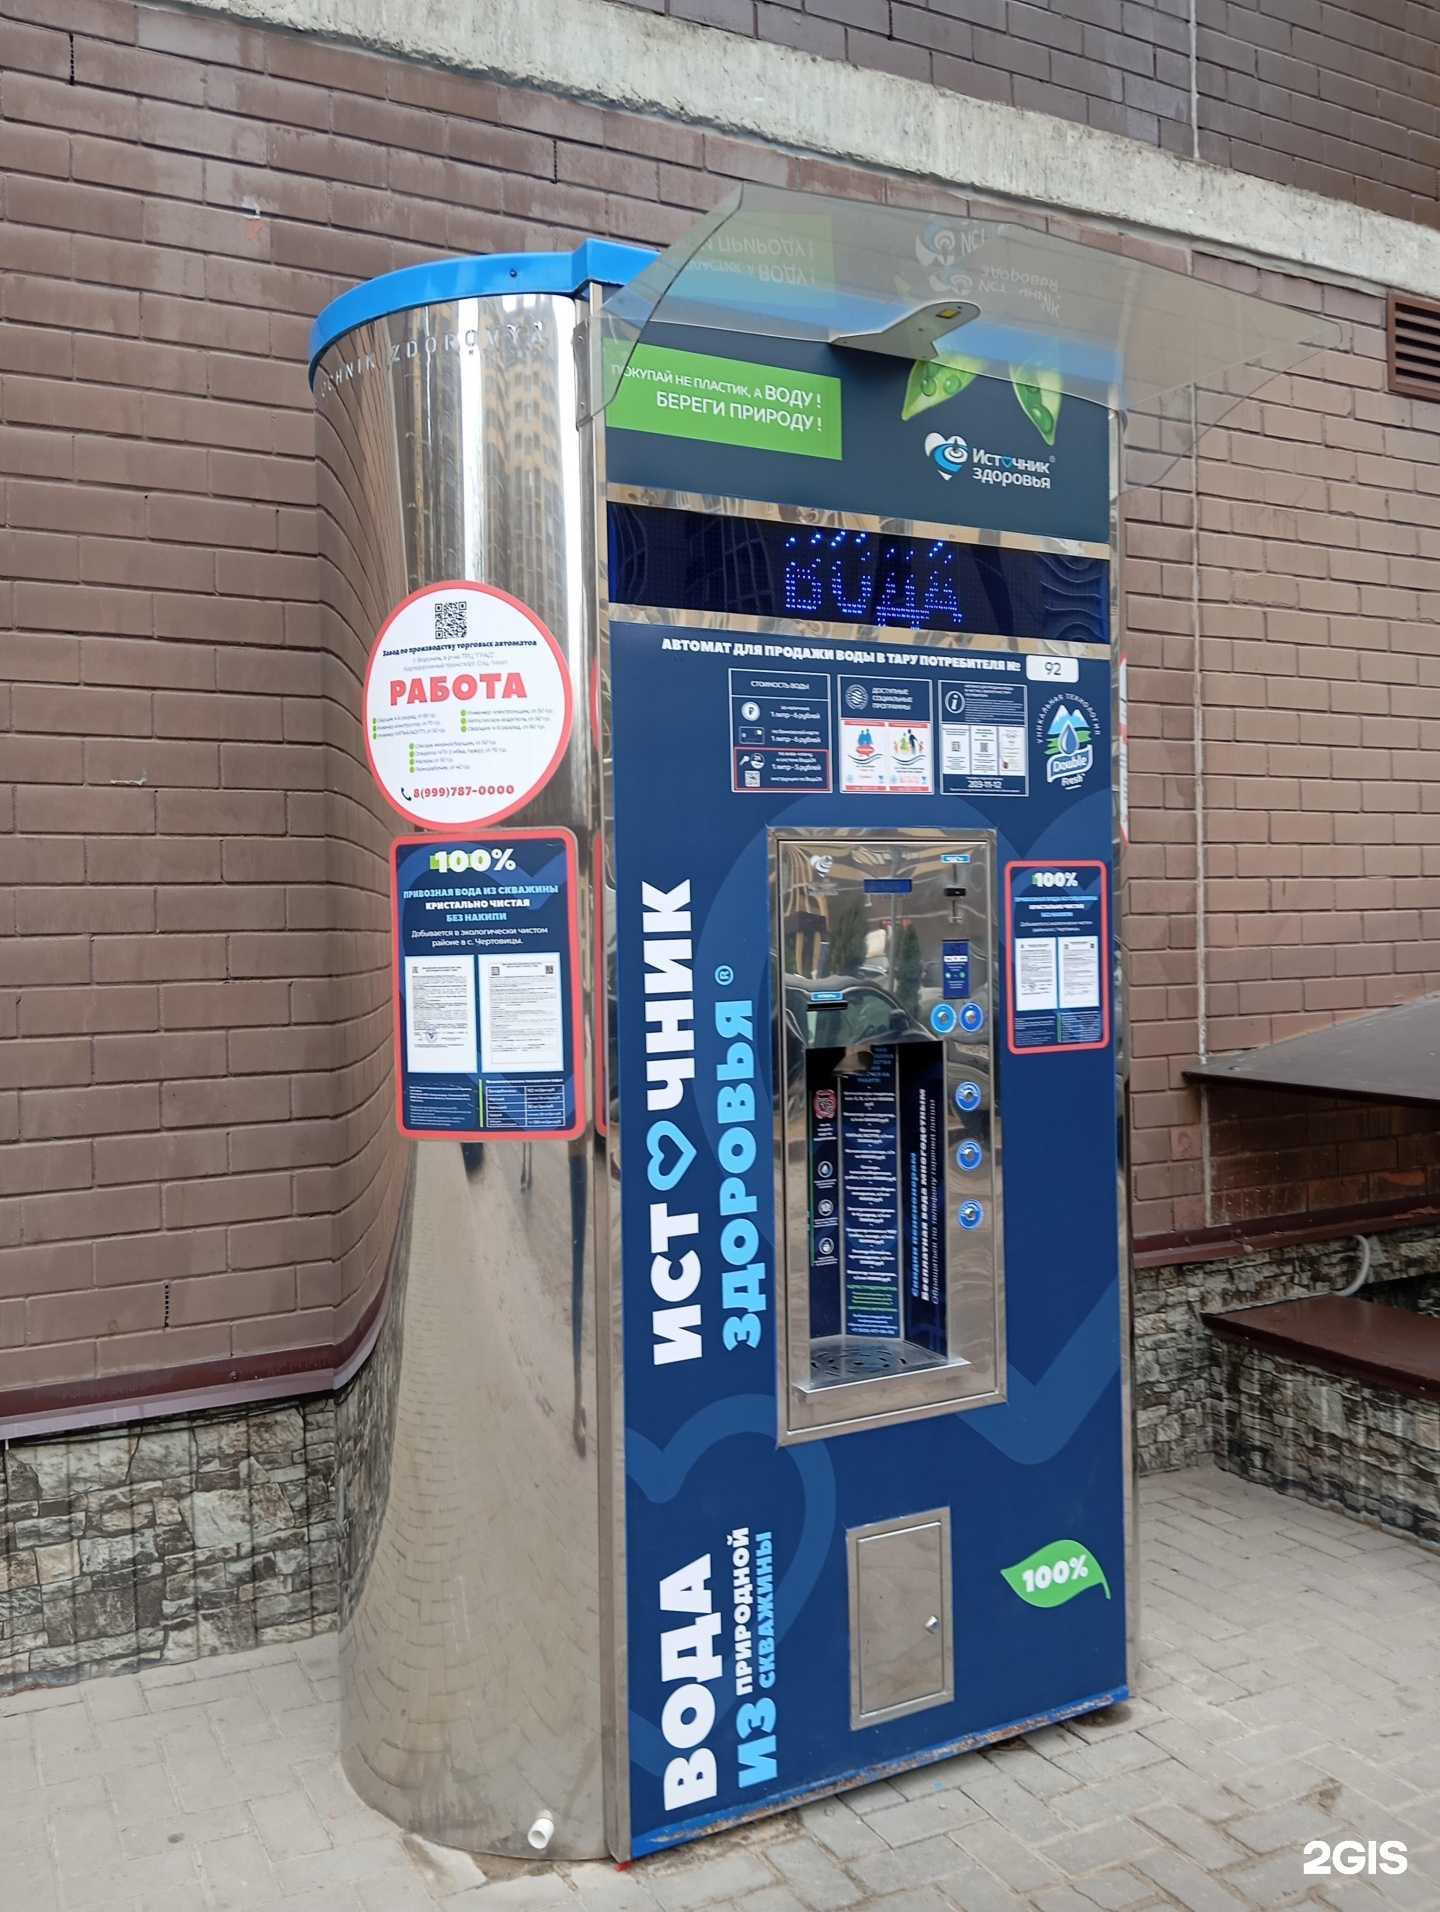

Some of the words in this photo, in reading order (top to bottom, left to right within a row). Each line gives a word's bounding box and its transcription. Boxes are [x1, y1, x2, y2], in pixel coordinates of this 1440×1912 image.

[611, 364, 673, 385] ПОКУПАЙ
[675, 374, 692, 388] НЕ
[693, 378, 751, 397] ПЛАСТИК,
[656, 391, 725, 416] БЕРЕГИ
[409, 643, 456, 655] производству
[456, 641, 494, 650] торговых
[494, 639, 537, 648] автоматов
[661, 638, 732, 653] АВТОМАТ
[733, 642, 763, 657] ДЛЯ
[764, 644, 834, 660] ПРОДАЖИ
[836, 649, 875, 664] ВОДЫ
[876, 652, 886, 663] В
[887, 653, 918, 666] ТАРУ
[919, 655, 1005, 672] ПОТРЕБИТЕЛЯ
[1044, 661, 1062, 676] 92
[390, 672, 528, 706] РАБОТА
[434, 848, 517, 874] 100%
[403, 889, 454, 899] ПРИВОЗНАЯ
[454, 888, 482, 898] ВОДА
[483, 886, 497, 895] ИЗ
[497, 884, 559, 895] СКВАЖИНЫ
[1034, 872, 1079, 888] 100%
[425, 900, 489, 910] КРИСТАЛЬНО
[489, 898, 530, 908] ЧИСТАЯ
[446, 914, 464, 922] БЕЗ
[464, 912, 507, 922] НАКИПИ
[715, 1000, 767, 1351] ЗДОРОВЬЯ
[1022, 1554, 1089, 1593] 100%
[726, 1527, 754, 1696] ПРИРОДНОЙ
[755, 1531, 776, 1690] СКВАЖИНЫ
[659, 1553, 723, 1812] ВОДА
[735, 1697, 778, 1788] ИЗ
